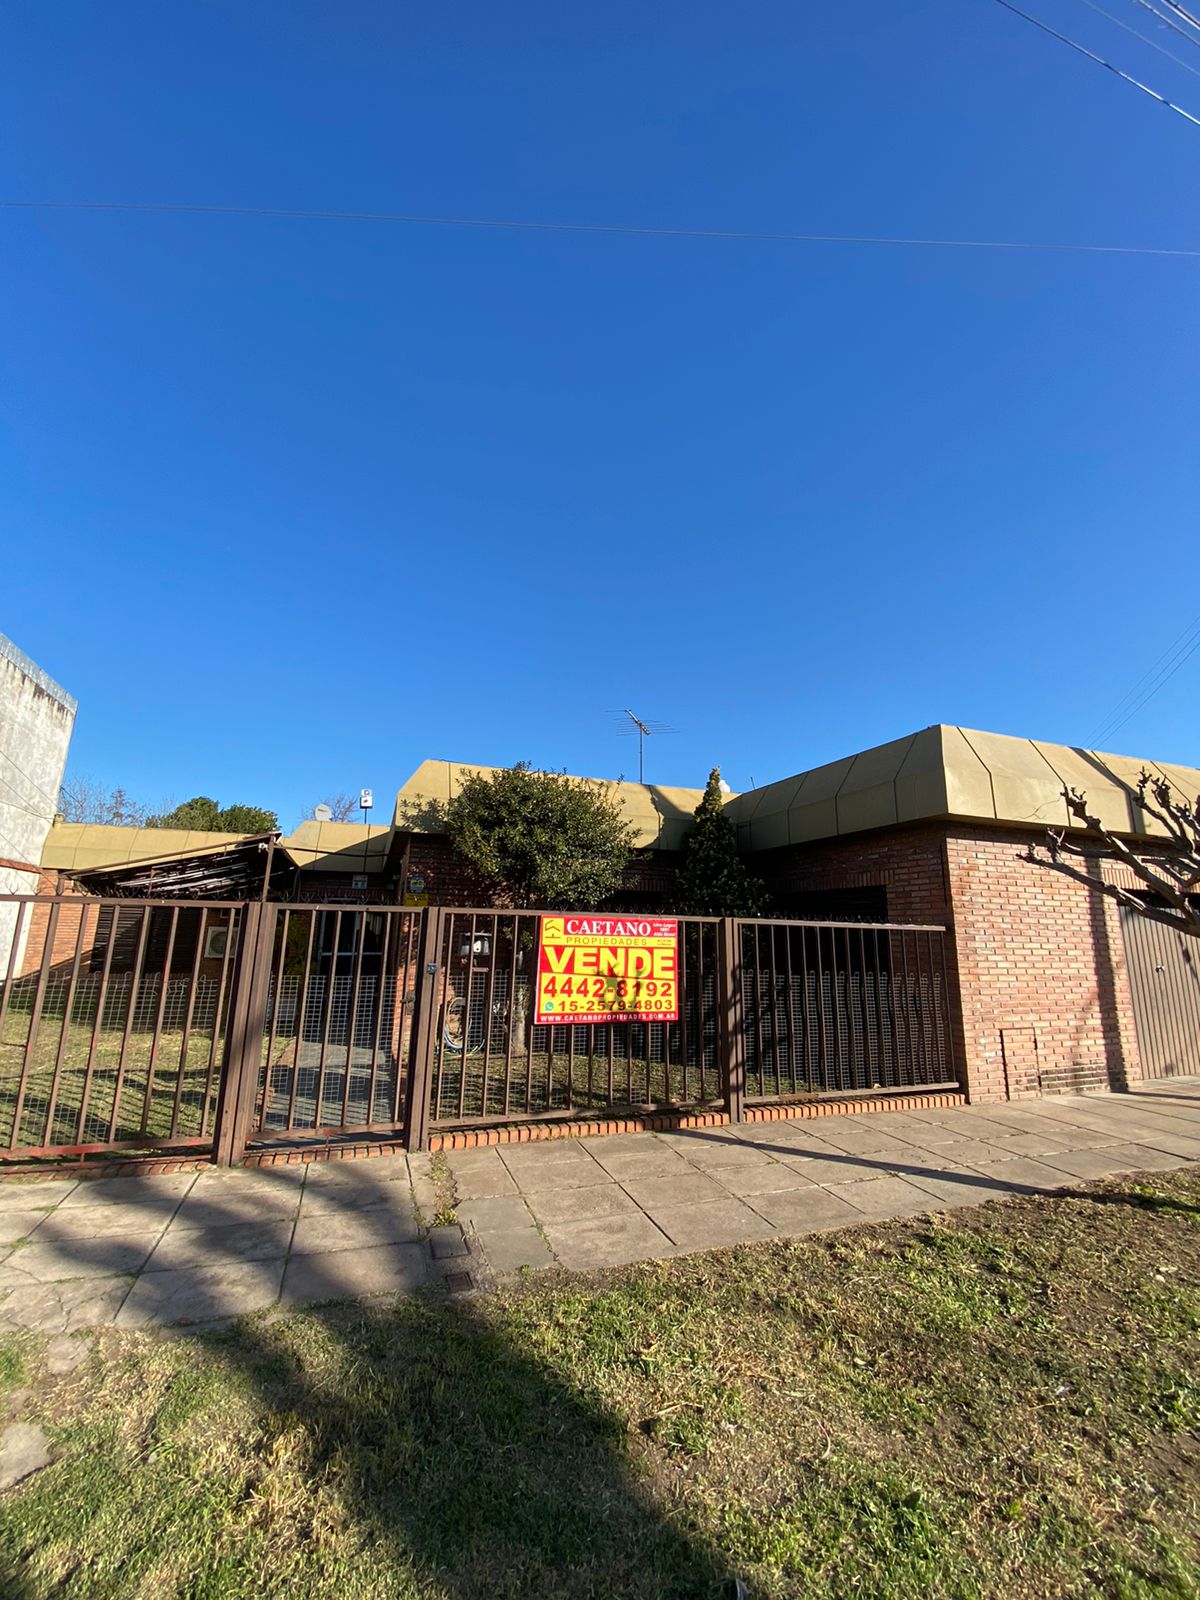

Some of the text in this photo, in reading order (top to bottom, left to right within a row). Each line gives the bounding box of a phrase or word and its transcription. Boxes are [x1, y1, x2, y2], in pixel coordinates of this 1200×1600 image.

[566, 920, 651, 936] CAETANO
[566, 937, 647, 946] PROPIEDADES
[543, 946, 675, 978] VENDE
[543, 976, 672, 998] 4442-8192
[558, 1000, 673, 1011] 15-2579-4803
